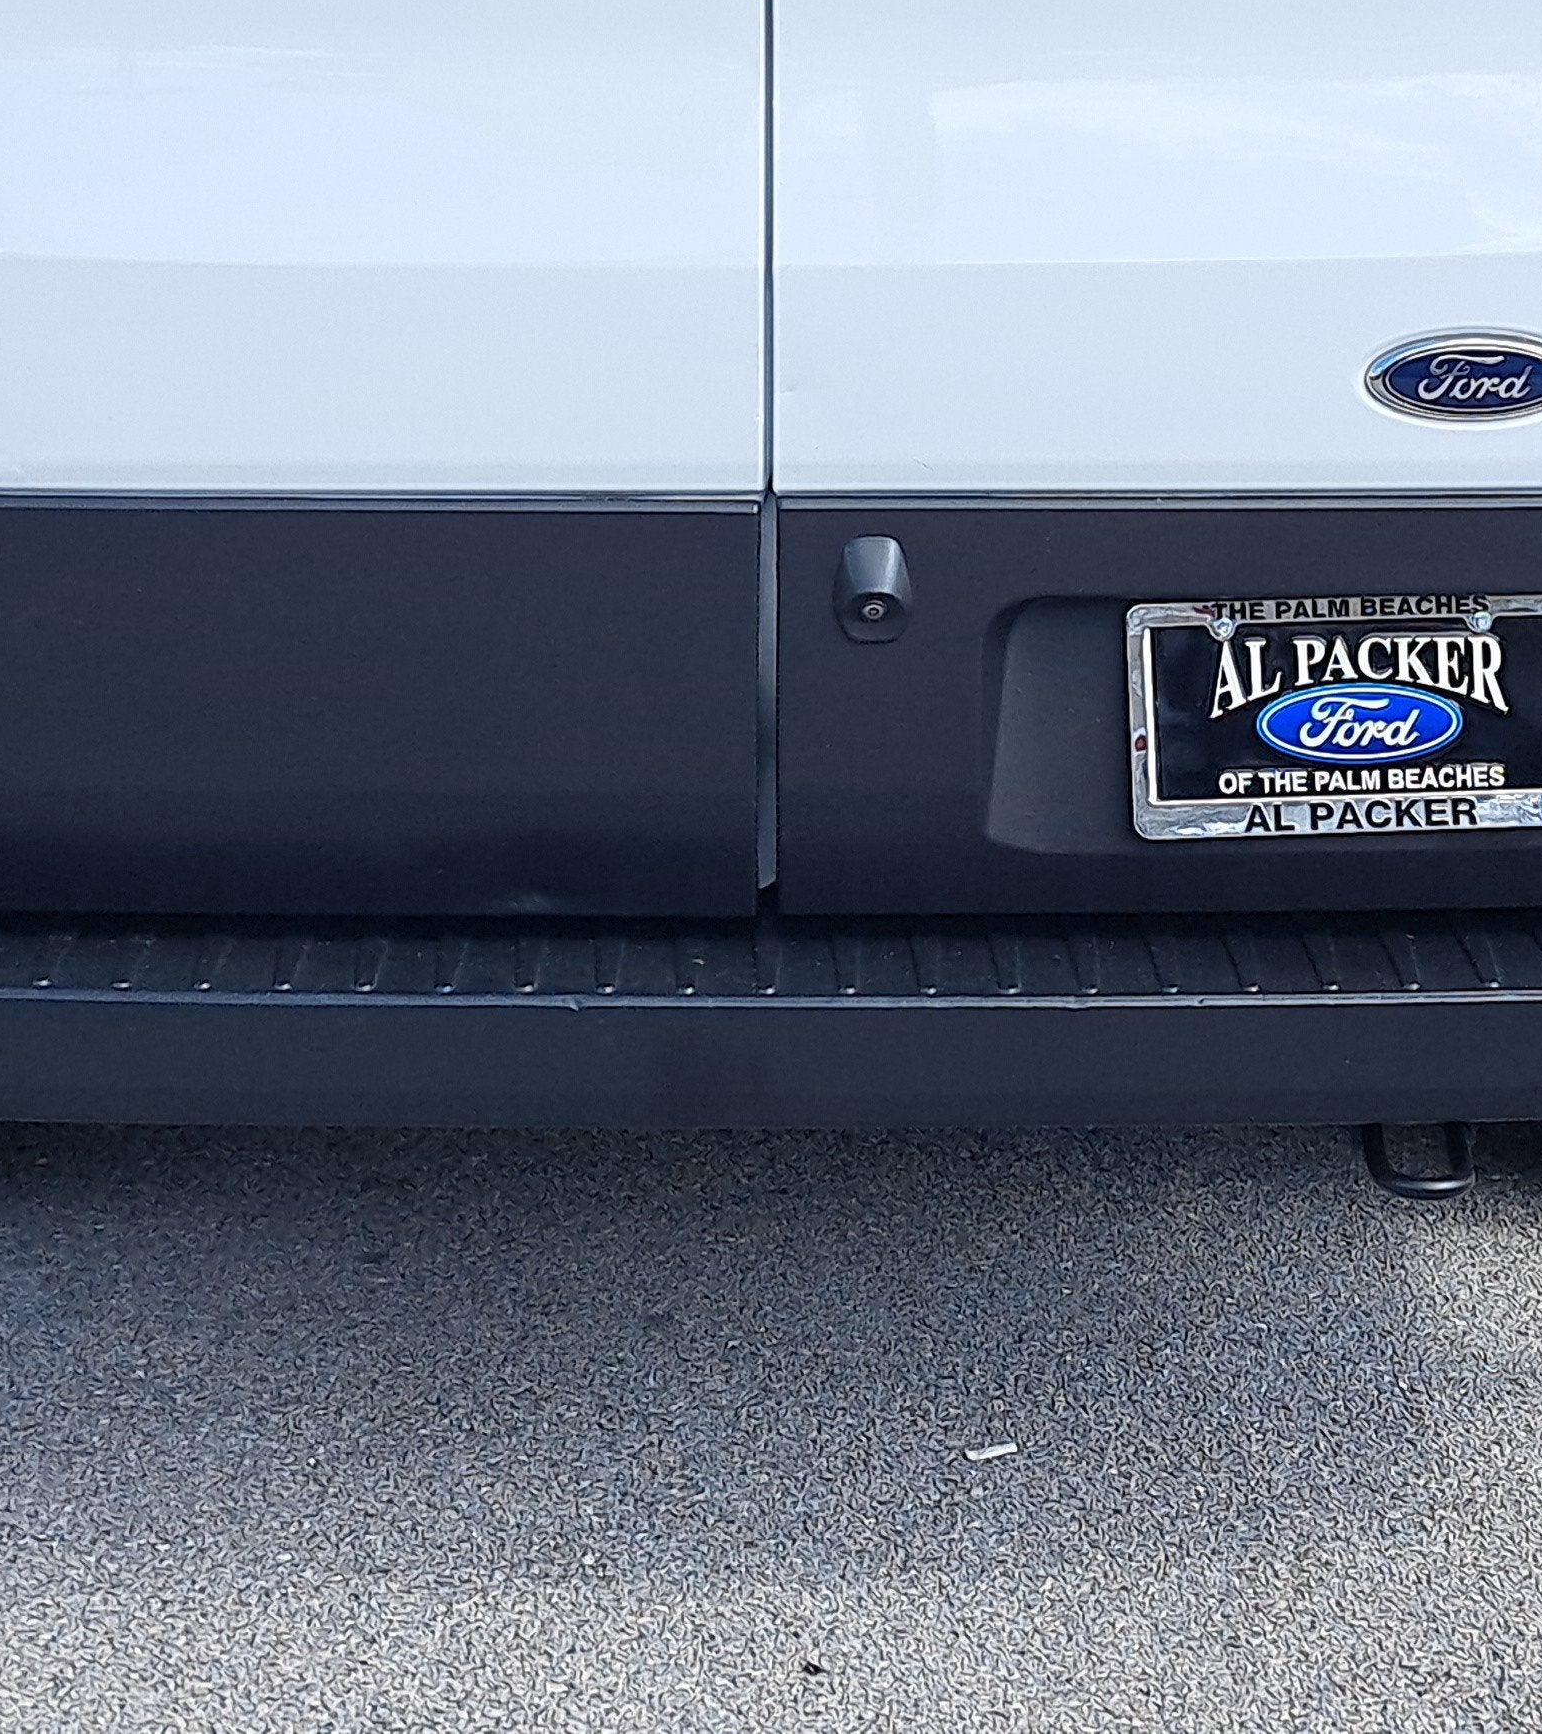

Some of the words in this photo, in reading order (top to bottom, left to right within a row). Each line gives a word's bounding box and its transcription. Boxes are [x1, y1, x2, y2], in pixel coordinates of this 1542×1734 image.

[1418, 354, 1532, 400] Ford
[1214, 602, 1266, 621] THE
[1275, 598, 1350, 619] PALM
[1359, 595, 1490, 616] BEACHES
[1209, 639, 1281, 718] AL
[1293, 636, 1509, 714] PACKER
[1300, 696, 1420, 748] Ford
[1218, 772, 1252, 795] OF
[1261, 770, 1308, 793] THE
[1314, 769, 1381, 792] PALM
[1387, 765, 1505, 790] BEACHES
[1244, 804, 1297, 833] AL
[1310, 796, 1479, 830] PACKER
